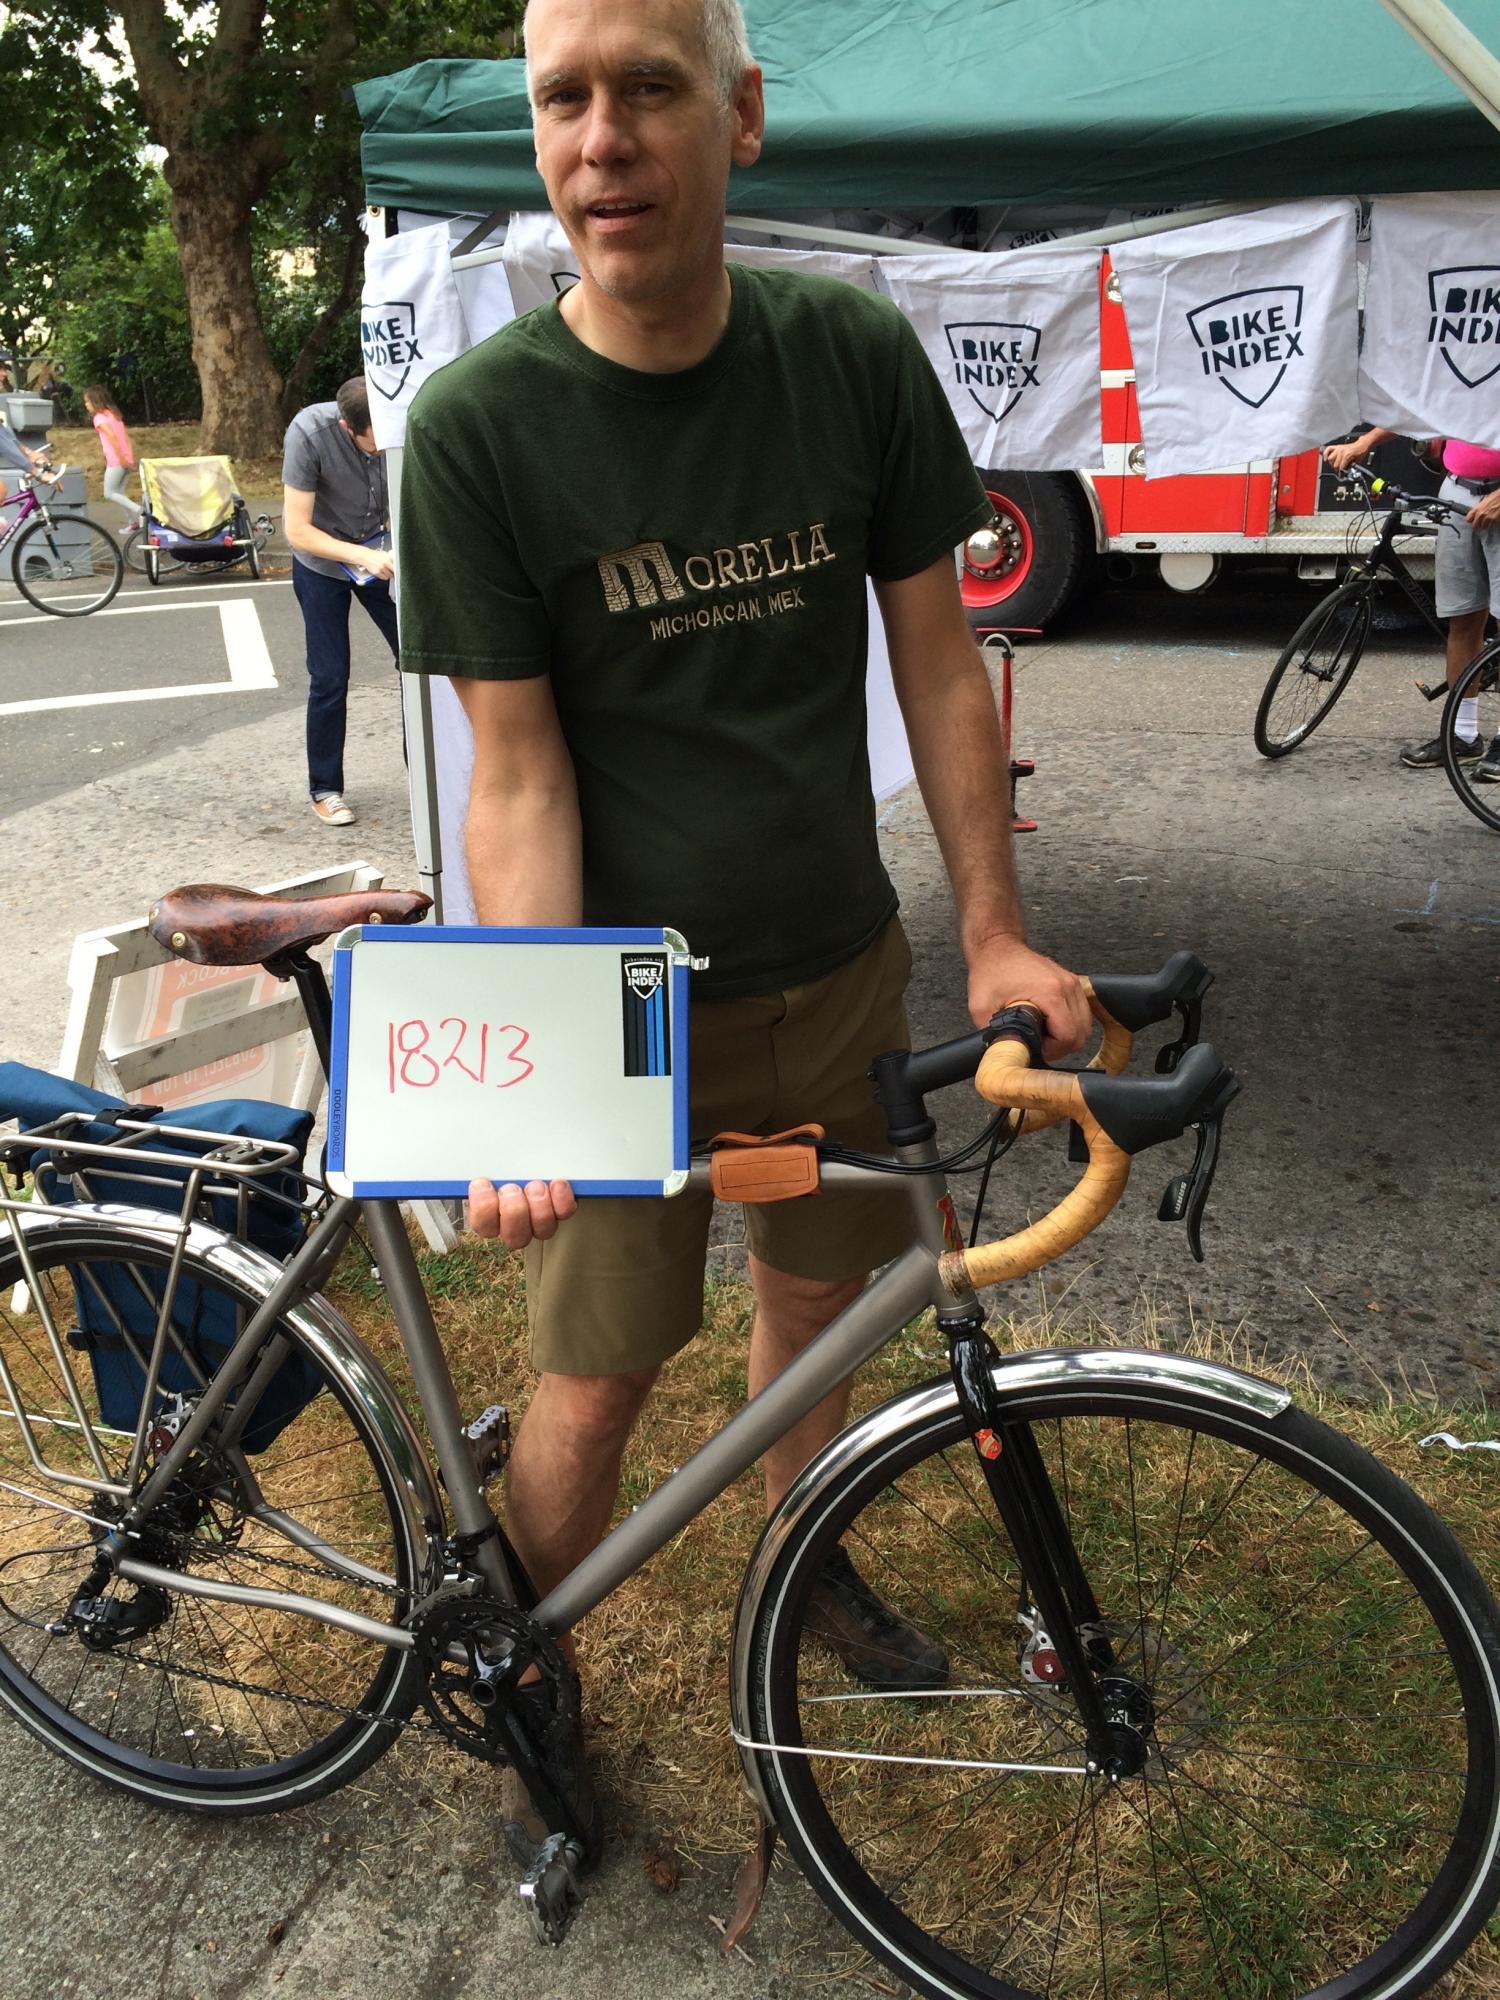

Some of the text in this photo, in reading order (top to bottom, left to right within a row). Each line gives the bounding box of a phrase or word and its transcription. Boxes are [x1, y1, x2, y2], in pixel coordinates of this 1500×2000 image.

[362, 317, 405, 343] BIKE
[1209, 305, 1286, 346] BIKE
[363, 338, 424, 366] NDEX
[962, 339, 1024, 363] BIKE
[1202, 331, 1304, 375] INDEX
[955, 362, 1041, 388] INDEX
[627, 976, 664, 986] INDEX
[631, 968, 657, 977] BIKE
[388, 1018, 534, 1093] 18213
[757, 1608, 773, 1684] MARATHON
